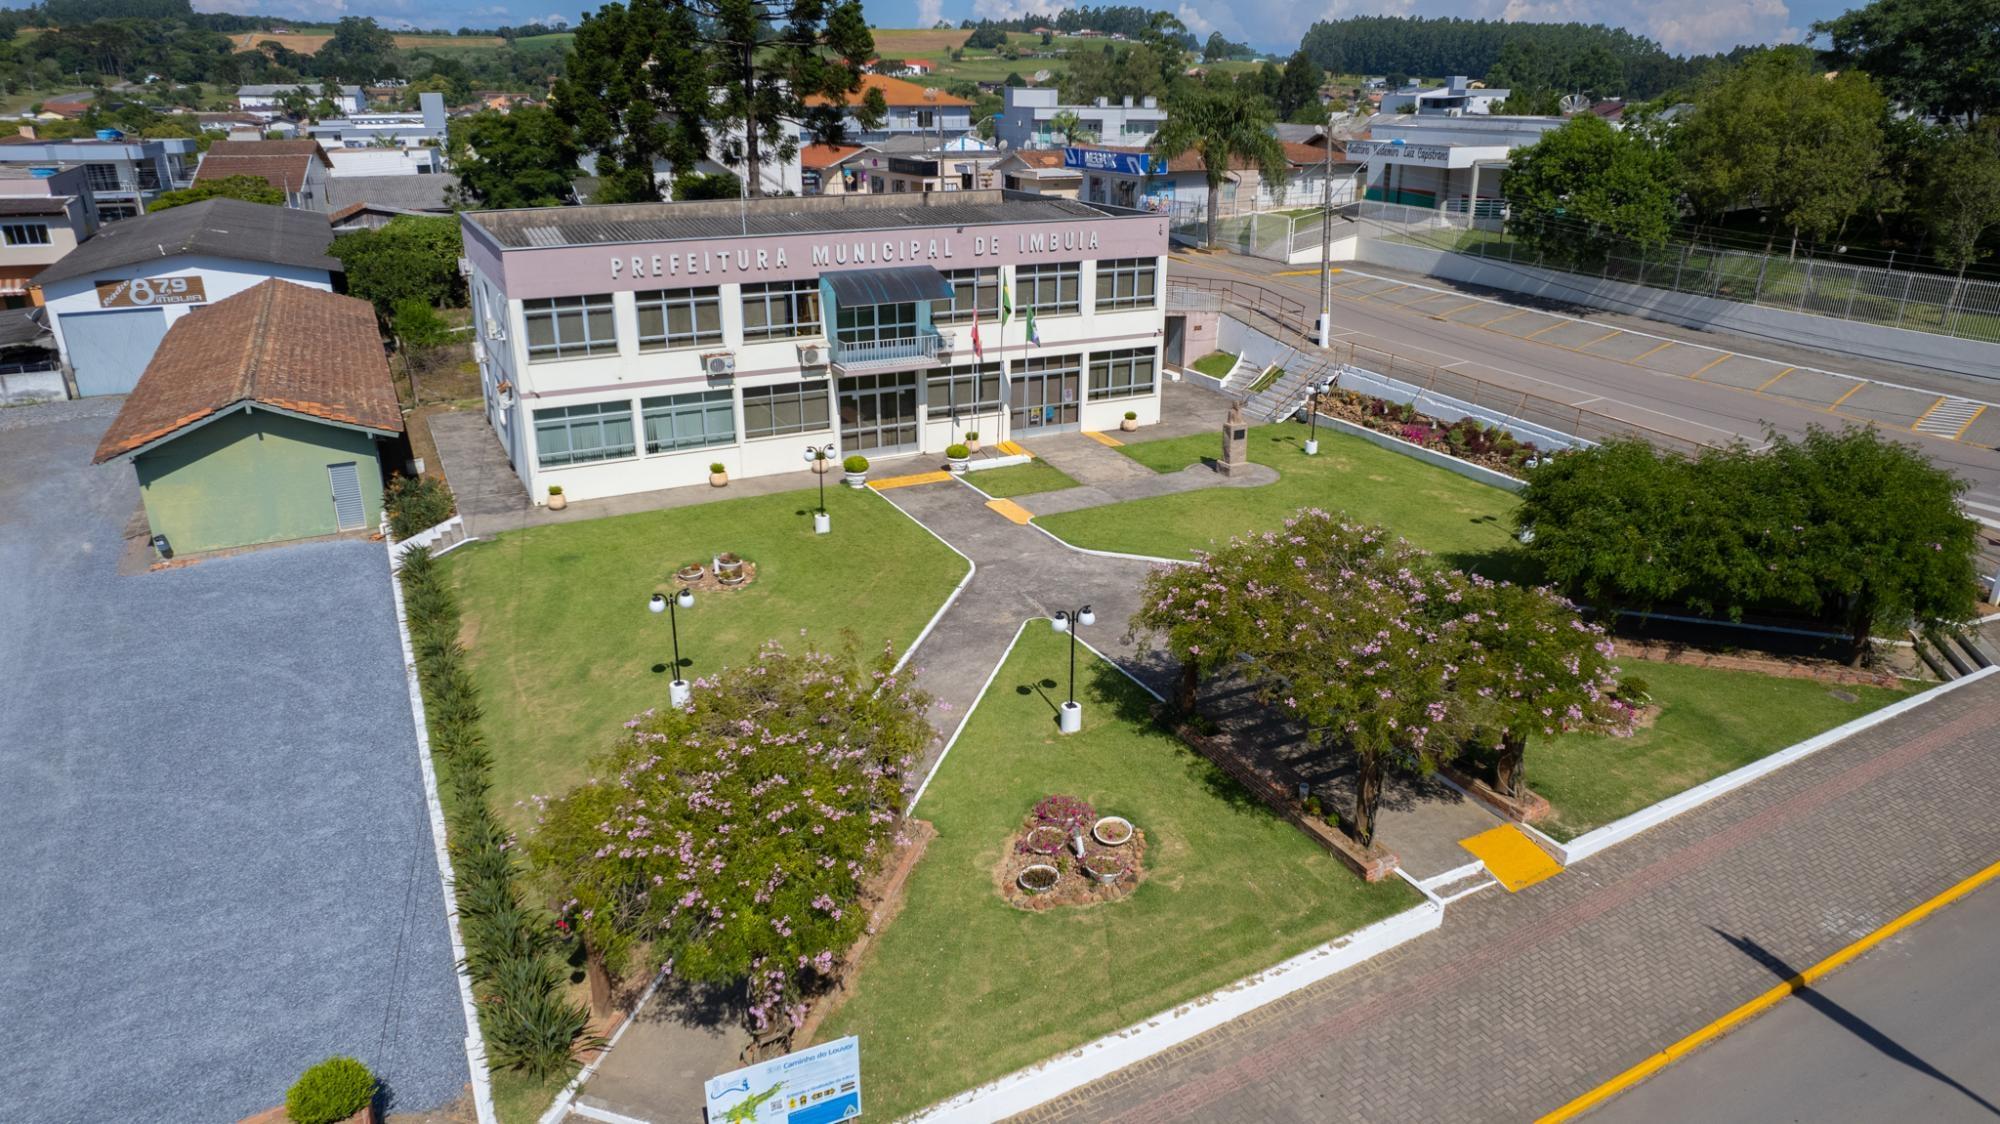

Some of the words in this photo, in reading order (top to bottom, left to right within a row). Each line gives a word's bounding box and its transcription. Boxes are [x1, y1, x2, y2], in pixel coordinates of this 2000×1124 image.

[610, 248, 788, 279] PREFEITURA
[812, 237, 953, 266] MUNICIPAL
[974, 236, 999, 256] DE
[1019, 231, 1098, 253] IMBUIA
[783, 1054, 816, 1069] Caminho
[828, 1043, 854, 1057] Louvor
